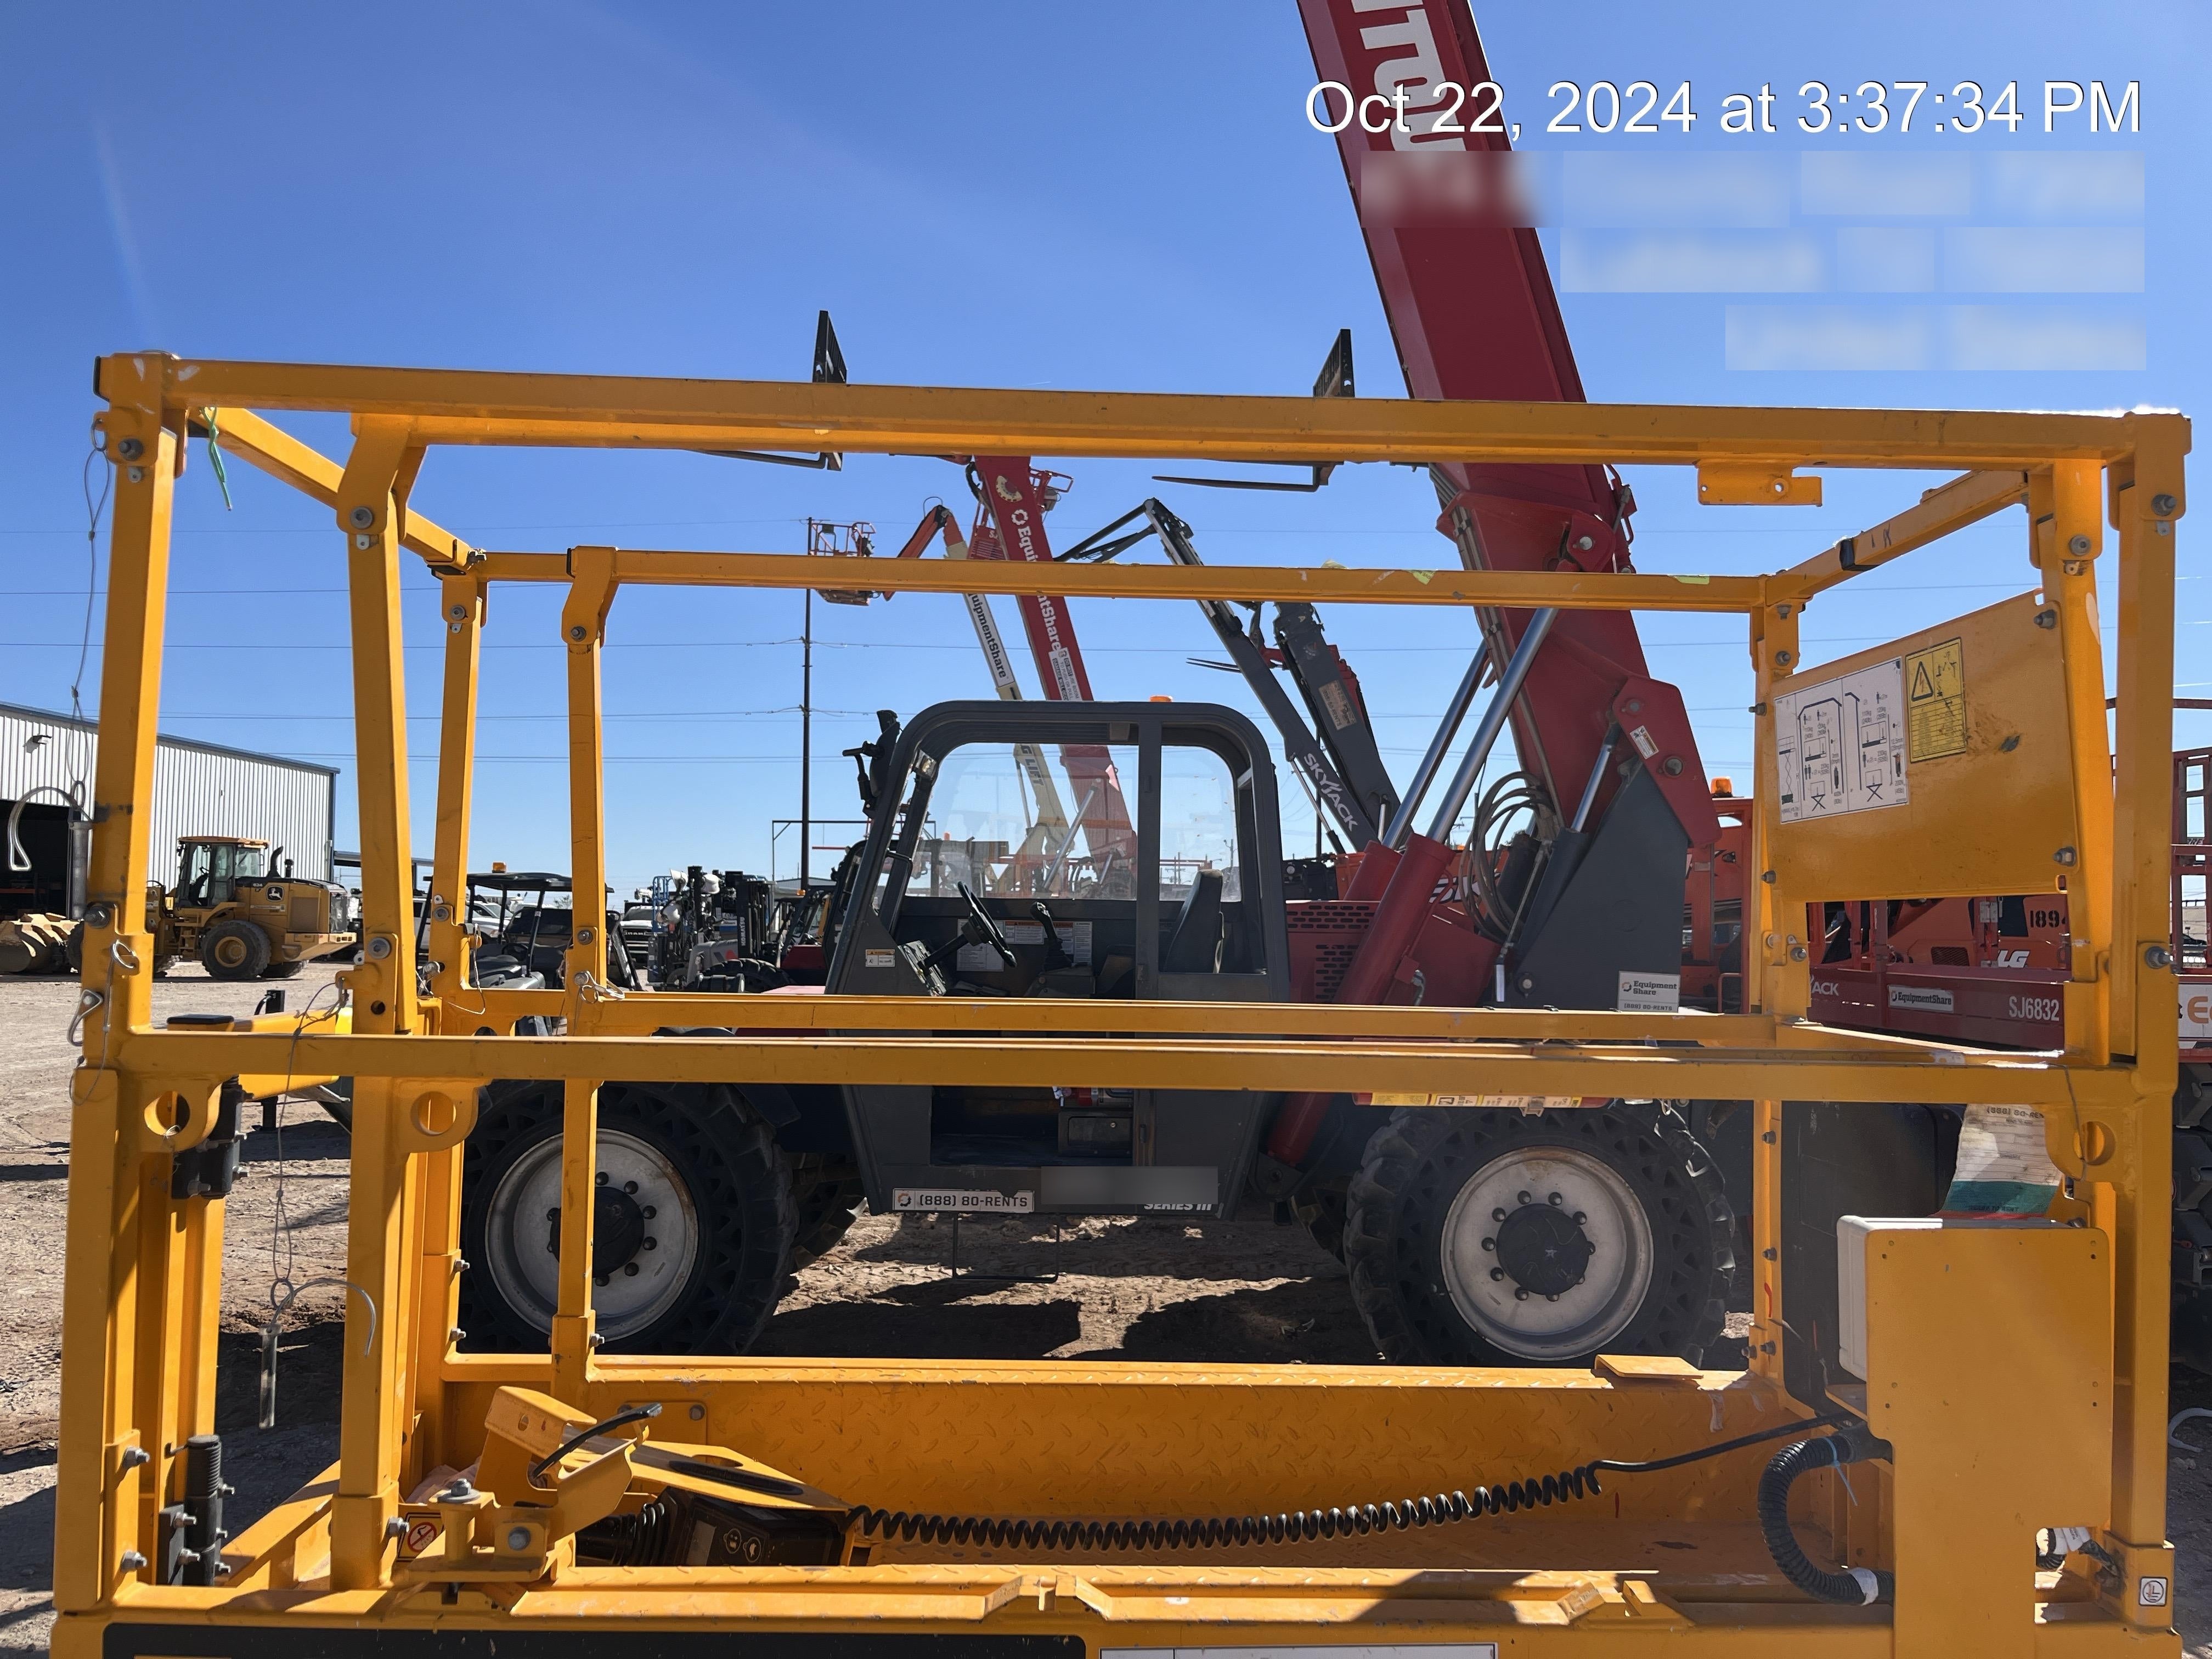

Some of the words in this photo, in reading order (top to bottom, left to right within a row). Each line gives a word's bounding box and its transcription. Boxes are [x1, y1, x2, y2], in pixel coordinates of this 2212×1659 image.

[1025, 759, 1043, 786] LIFT
[1304, 752, 1358, 832] SKYJACK
[1997, 950, 2030, 968] LG
[1633, 980, 1677, 990] Equipment
[1898, 991, 1952, 1005] EquipmentShare
[2009, 996, 2059, 1022] SJ6832
[919, 1195, 956, 1206] (888)
[961, 1196, 1028, 1207] 80-RENTS
